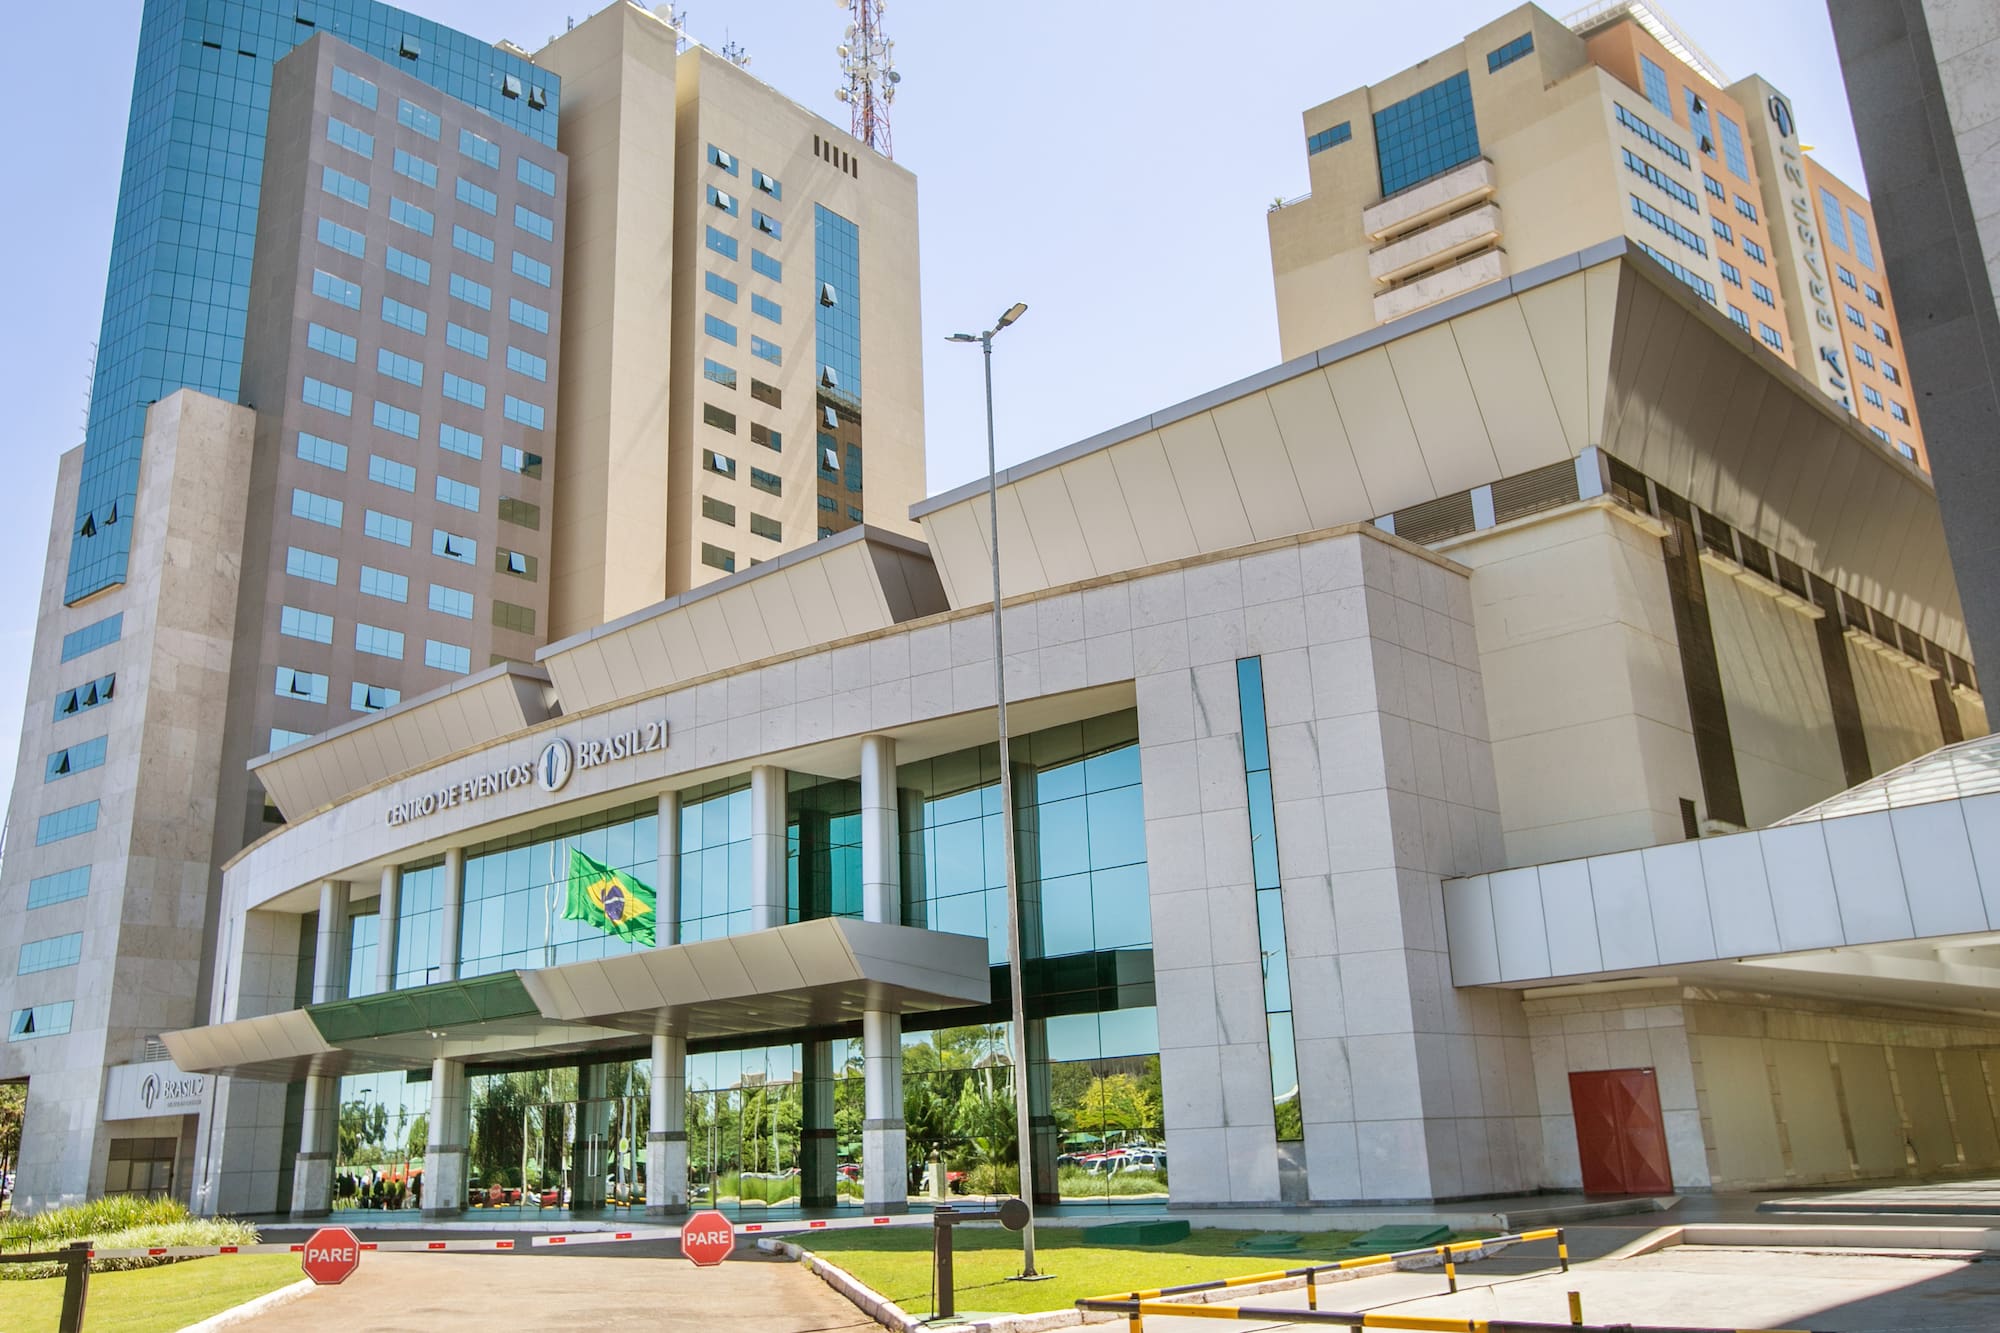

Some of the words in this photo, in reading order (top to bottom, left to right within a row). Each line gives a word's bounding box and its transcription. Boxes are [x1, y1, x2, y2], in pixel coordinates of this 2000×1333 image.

[385, 794, 436, 826] CENTRO
[439, 784, 461, 809] DE
[461, 762, 533, 802] EVENTOS
[686, 1230, 729, 1246] PARE
[308, 1247, 353, 1263] PARE
